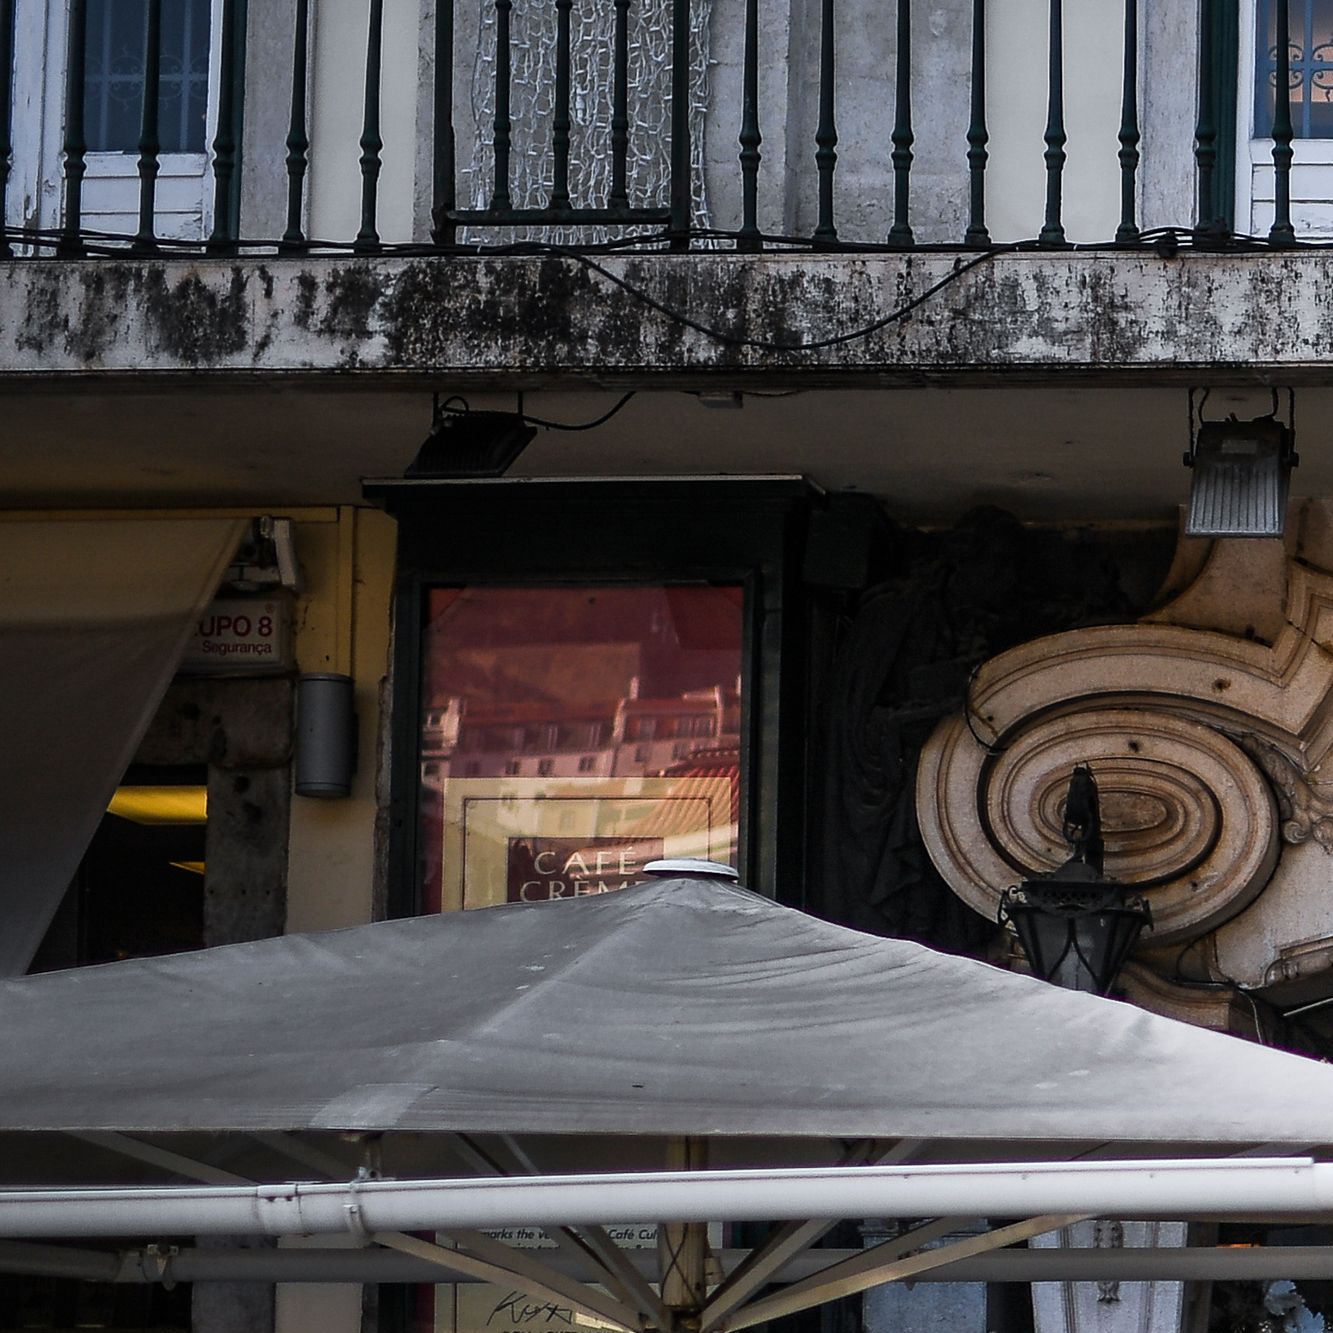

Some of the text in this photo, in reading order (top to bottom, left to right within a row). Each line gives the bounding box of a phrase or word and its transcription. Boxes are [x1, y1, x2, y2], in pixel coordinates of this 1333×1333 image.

[258, 616, 272, 637] 8
[202, 639, 272, 656] Segurança
[533, 846, 637, 876] CAFÉ
[517, 1228, 534, 1239] the
[608, 1228, 635, 1240] Café
